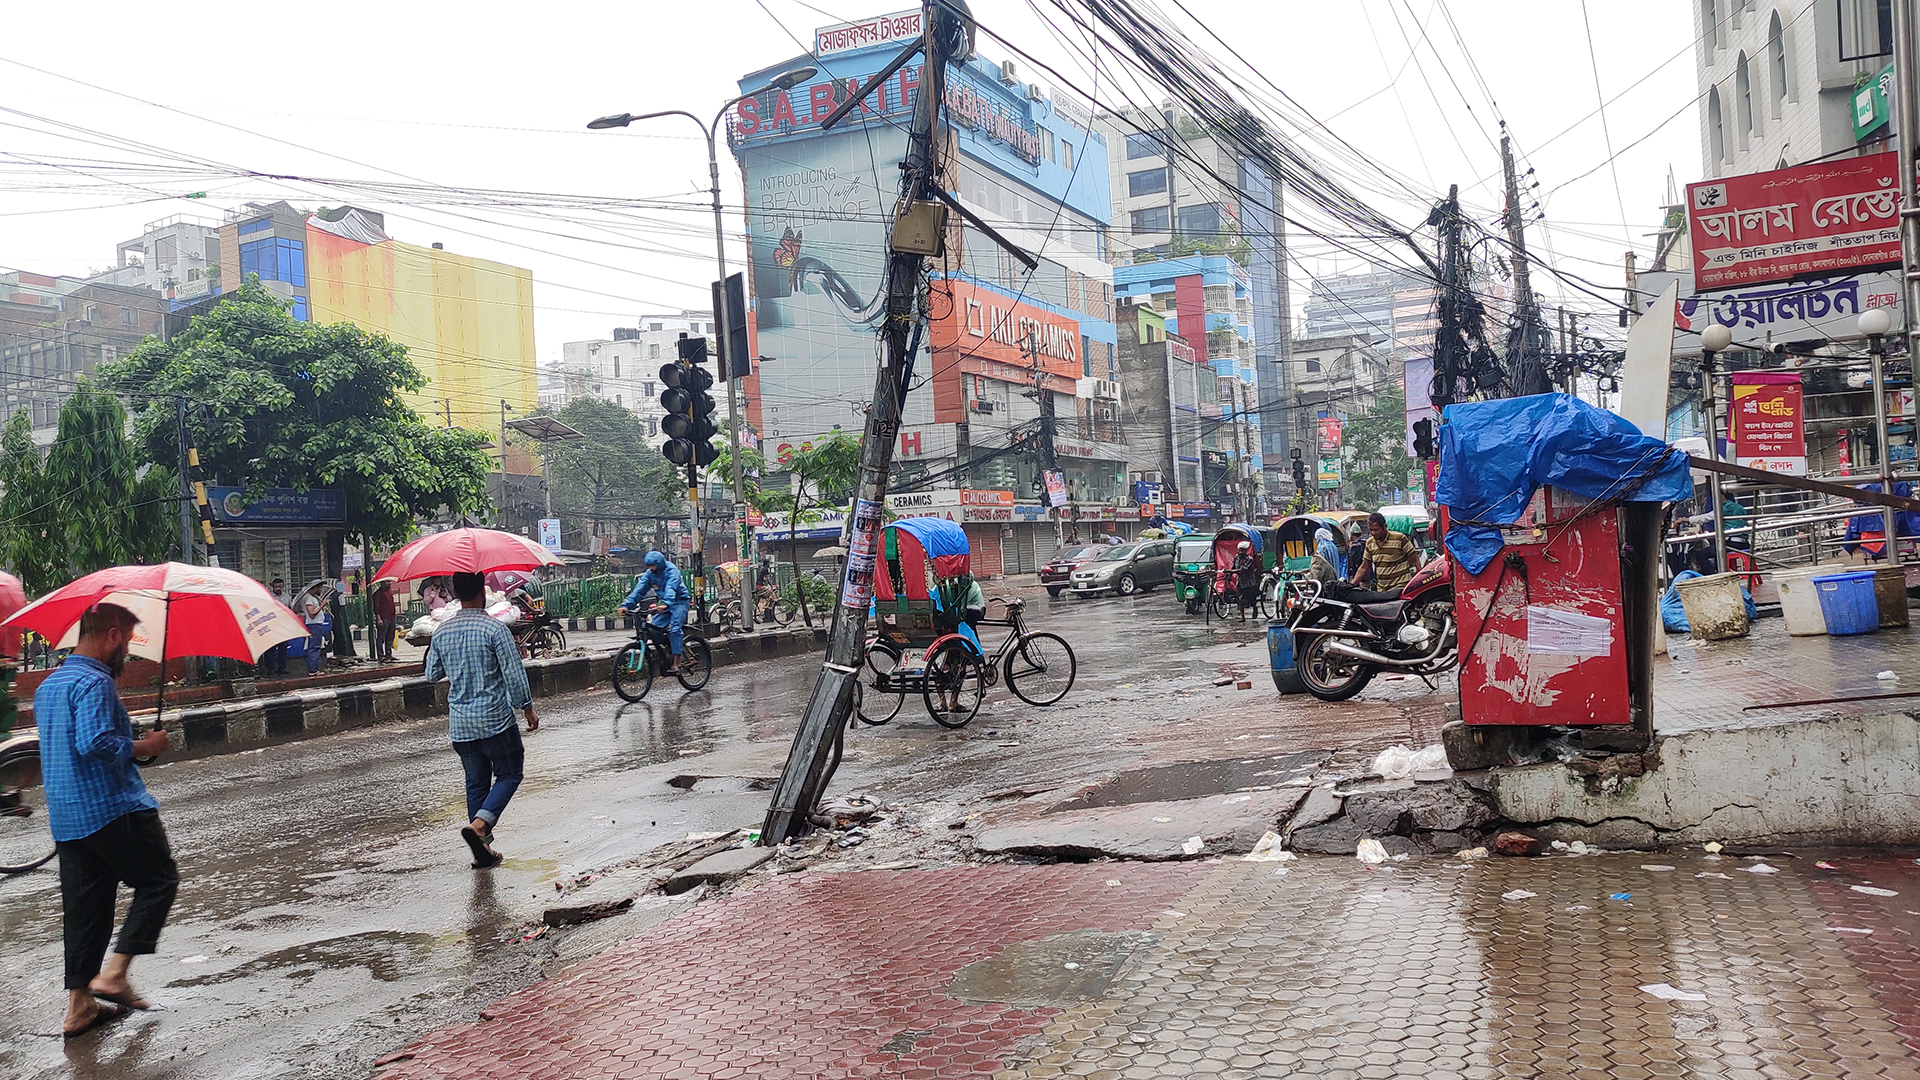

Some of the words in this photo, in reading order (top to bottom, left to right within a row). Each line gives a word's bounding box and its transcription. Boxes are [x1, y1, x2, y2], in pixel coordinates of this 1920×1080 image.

[879, 13, 922, 41] টাওয়ার
[760, 167, 836, 191] INTRODUCING
[762, 184, 835, 212] BEAUTY
[834, 176, 860, 203] with
[763, 199, 870, 233] BRILLIANCE
[1696, 202, 1799, 242] আলম
[1739, 248, 1766, 260] মিনি
[1770, 240, 1819, 256] চাইনিজ
[1829, 231, 1876, 249] শীততাপ
[1713, 278, 1860, 330] ওয়ালটন
[1866, 292, 1898, 310] প্লাজা
[1018, 315, 1077, 363] CERAMICS
[1746, 432, 1773, 440] মোবাইল
[1770, 461, 1794, 470] নগদ
[893, 494, 933, 508] CERAMICS
